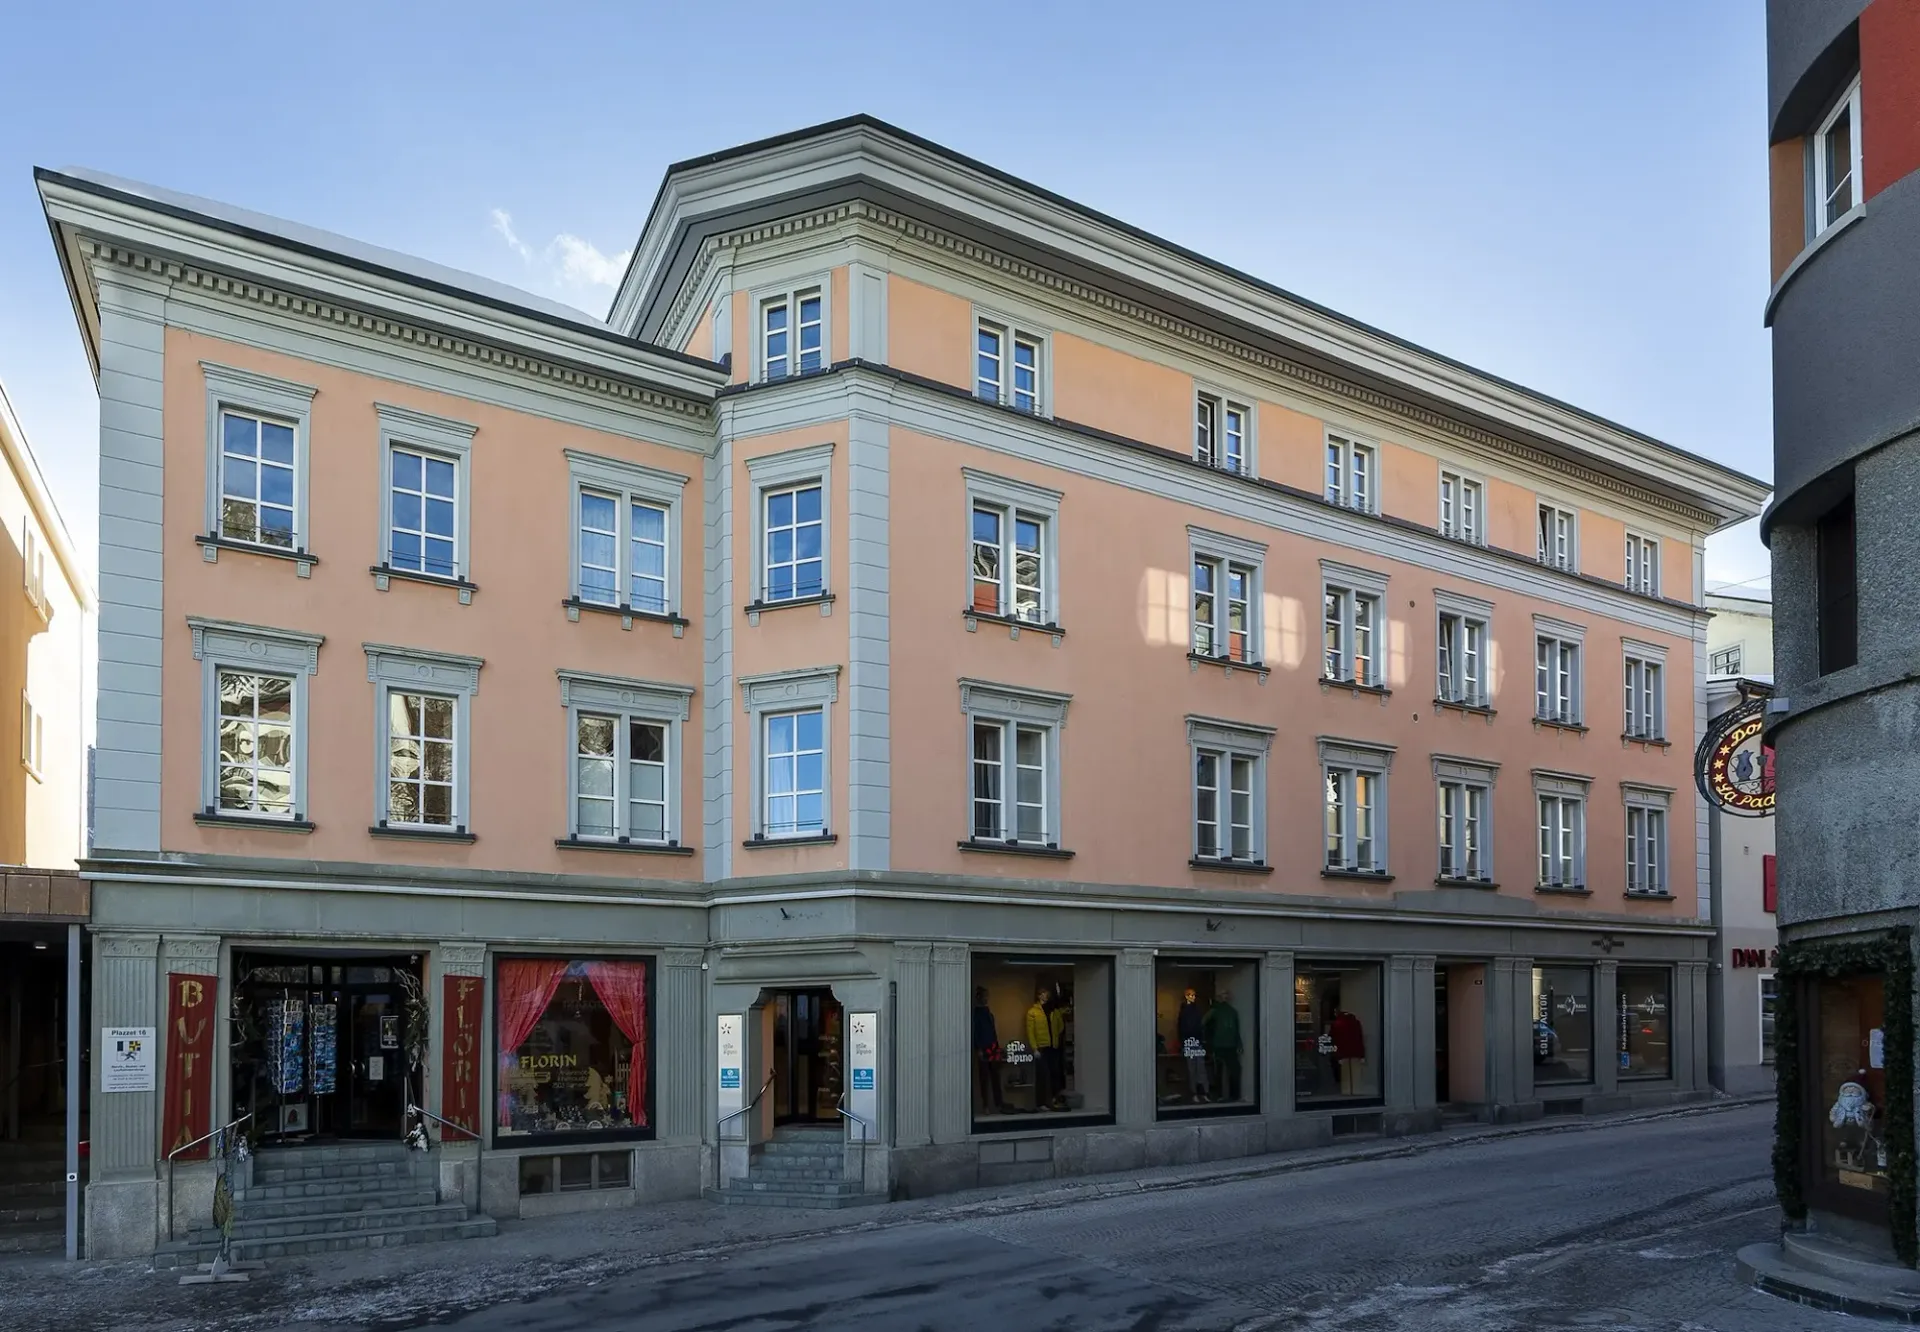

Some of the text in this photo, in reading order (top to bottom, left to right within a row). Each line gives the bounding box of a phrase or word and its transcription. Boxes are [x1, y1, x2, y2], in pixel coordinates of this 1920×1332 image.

[1716, 783, 1738, 802] La
[1006, 1040, 1026, 1051] stile
[1184, 1036, 1200, 1047] stile
[520, 1054, 577, 1069] FLORIN
[1006, 1051, 1034, 1065] alpino
